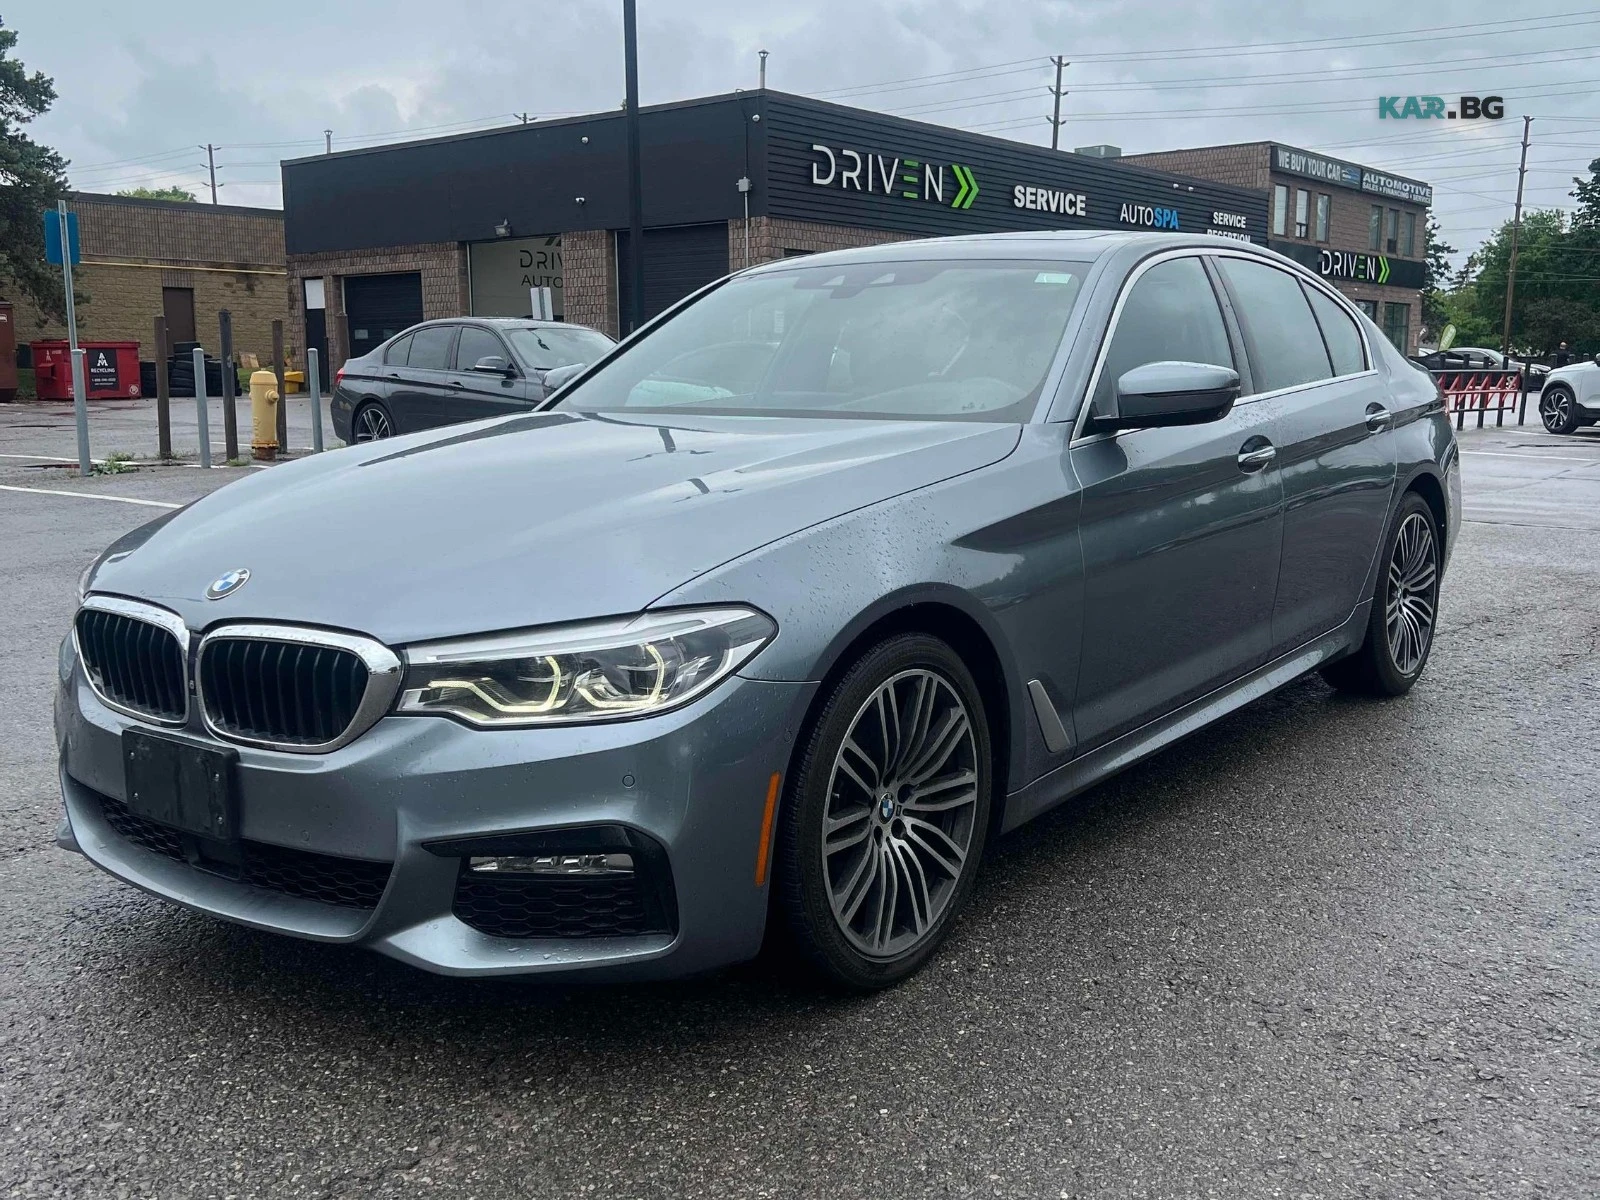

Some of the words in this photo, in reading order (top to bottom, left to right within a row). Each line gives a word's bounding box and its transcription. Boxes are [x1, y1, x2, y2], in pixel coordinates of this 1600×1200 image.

[812, 144, 943, 202] DRIVEN
[1278, 150, 1290, 168] WE
[1291, 154, 1306, 173] BUY
[1307, 158, 1326, 178] YOUR
[1327, 163, 1341, 181] CAR
[1362, 173, 1432, 197] AUTOMOTIVE
[1362, 182, 1379, 192] SALES
[1013, 185, 1086, 217] SERVICE
[1212, 211, 1247, 229] SERVICE
[1321, 250, 1376, 280] DRIVEN
[521, 274, 563, 289] AUTO
